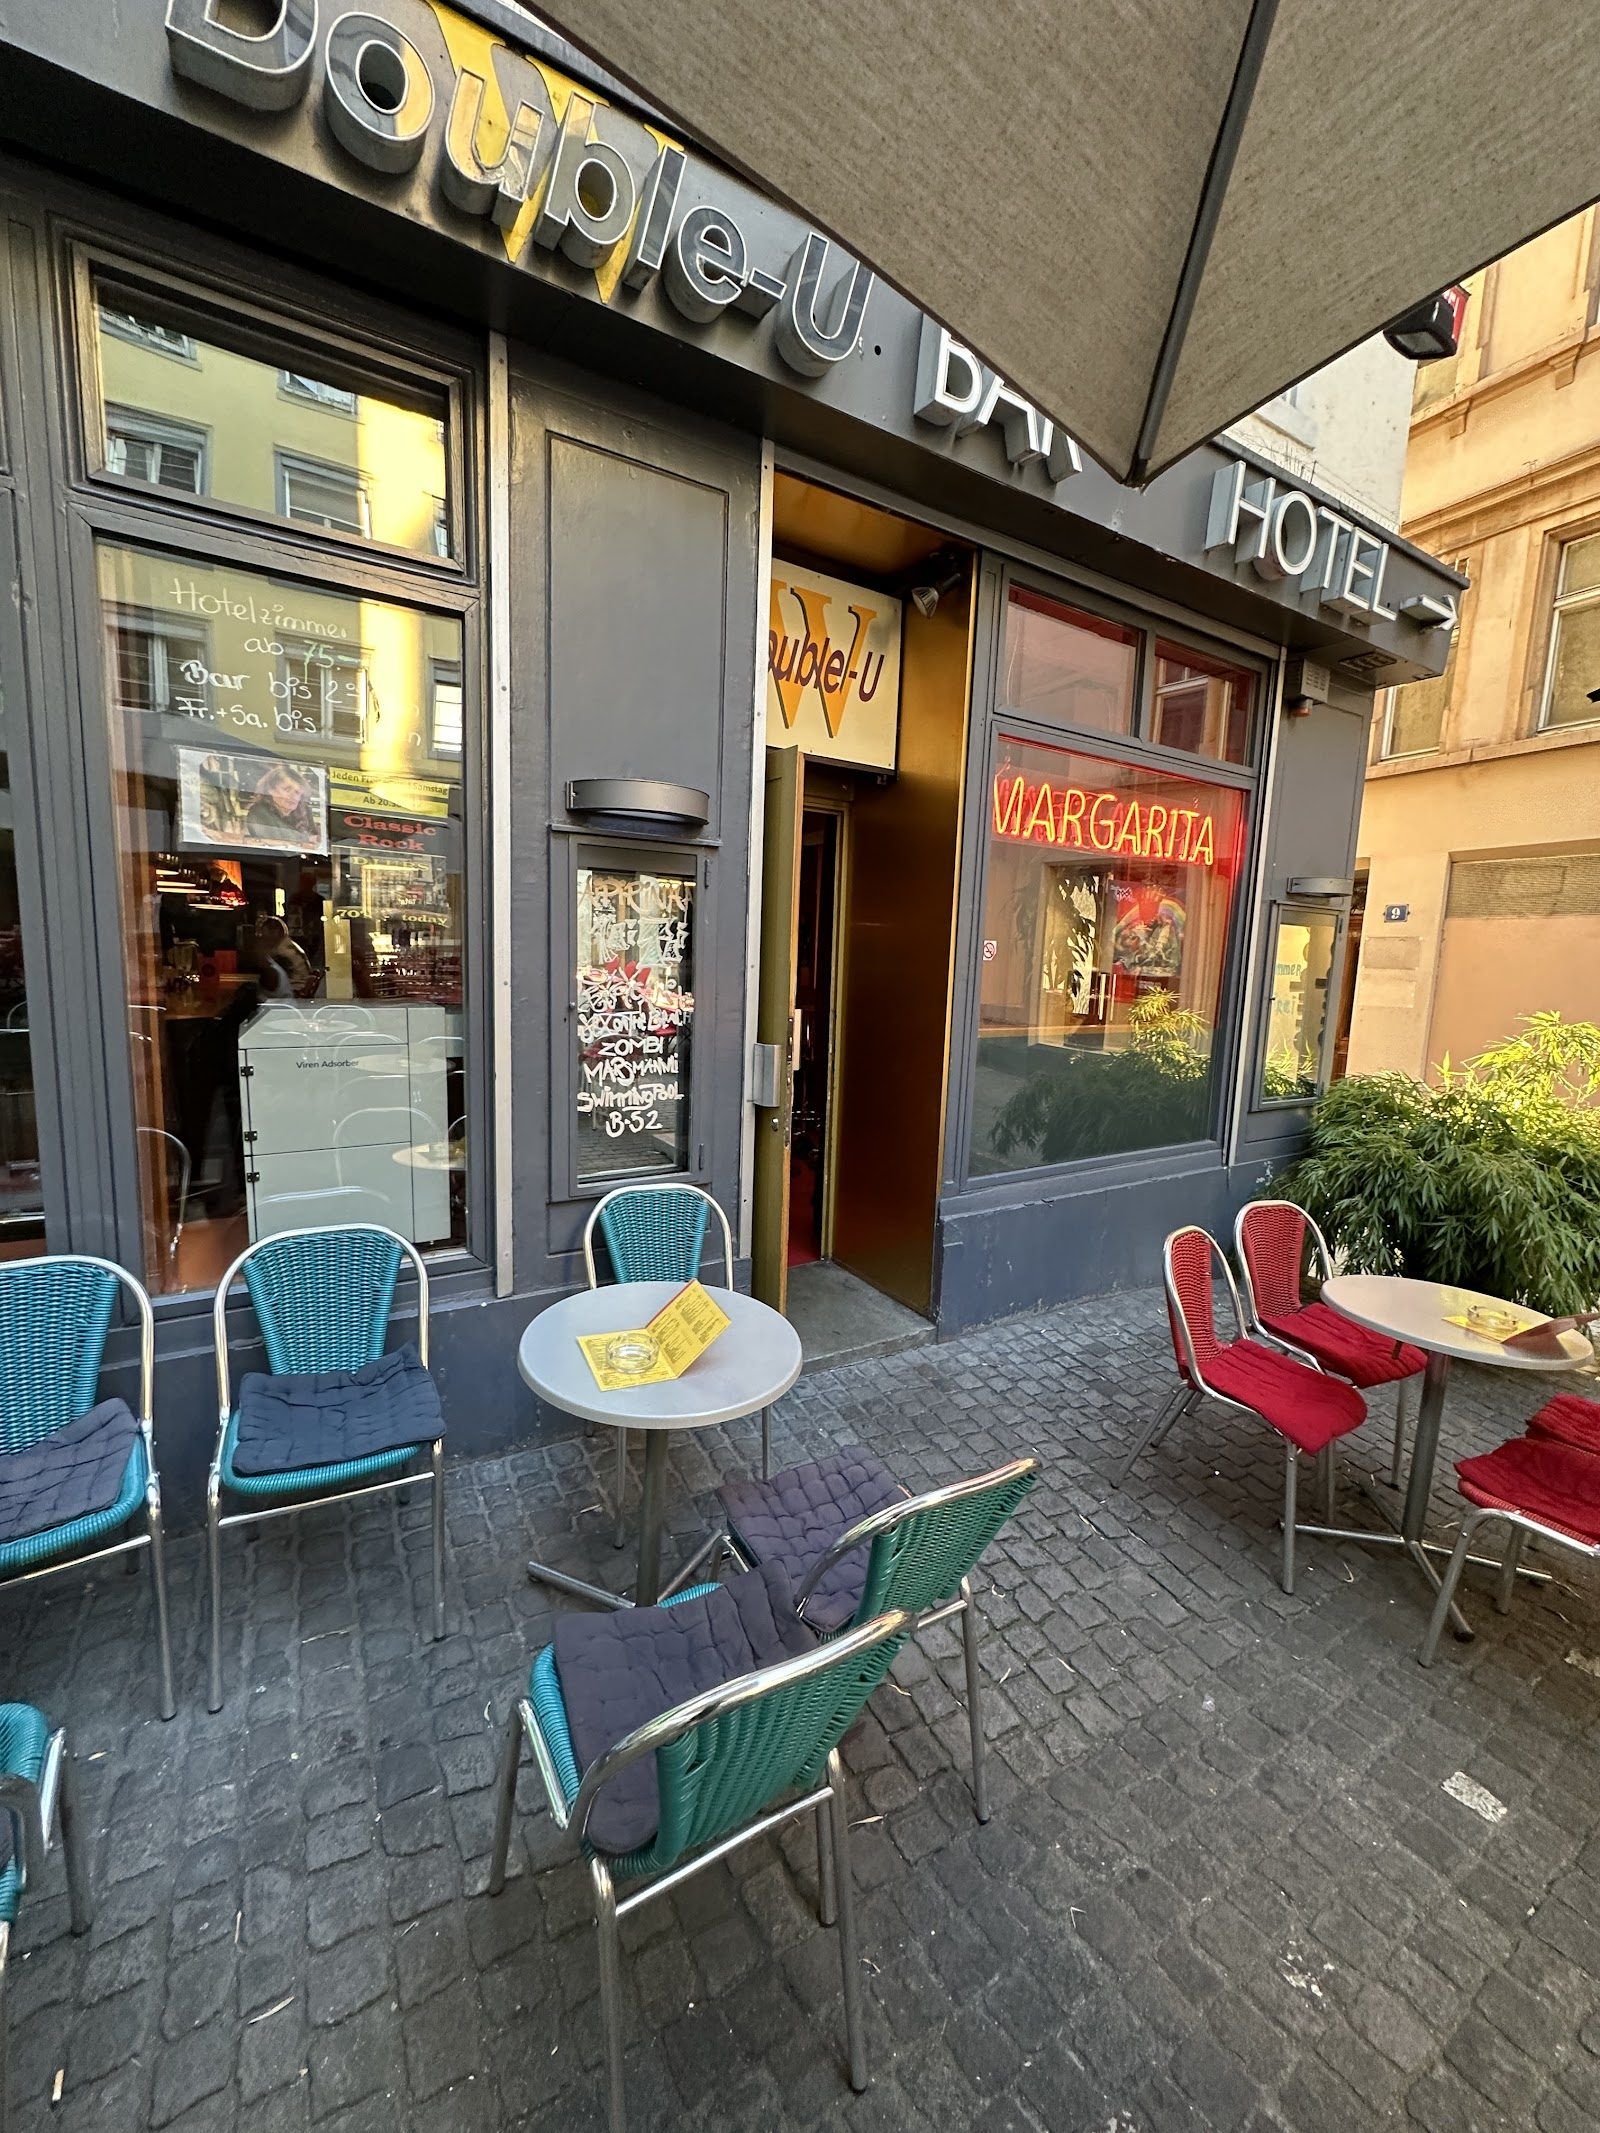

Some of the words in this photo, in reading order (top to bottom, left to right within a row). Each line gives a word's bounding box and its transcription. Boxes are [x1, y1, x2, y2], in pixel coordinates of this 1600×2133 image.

[1222, 459, 1398, 622] HOTEL
[244, 636, 284, 655] ab
[179, 659, 251, 691] Bar
[268, 671, 312, 699] bis
[273, 706, 317, 733] bis
[332, 771, 359, 783] Jeden
[363, 796, 375, 805] Ab
[343, 815, 437, 836] Classic
[992, 776, 1214, 866] MARGARITA
[357, 833, 425, 851] Rock
[402, 914, 449, 928] today
[1391, 907, 1401, 920] 9
[597, 1035, 664, 1057] ZOMBI
[296, 1061, 319, 1069] Viren
[322, 1059, 359, 1068] Adsorber
